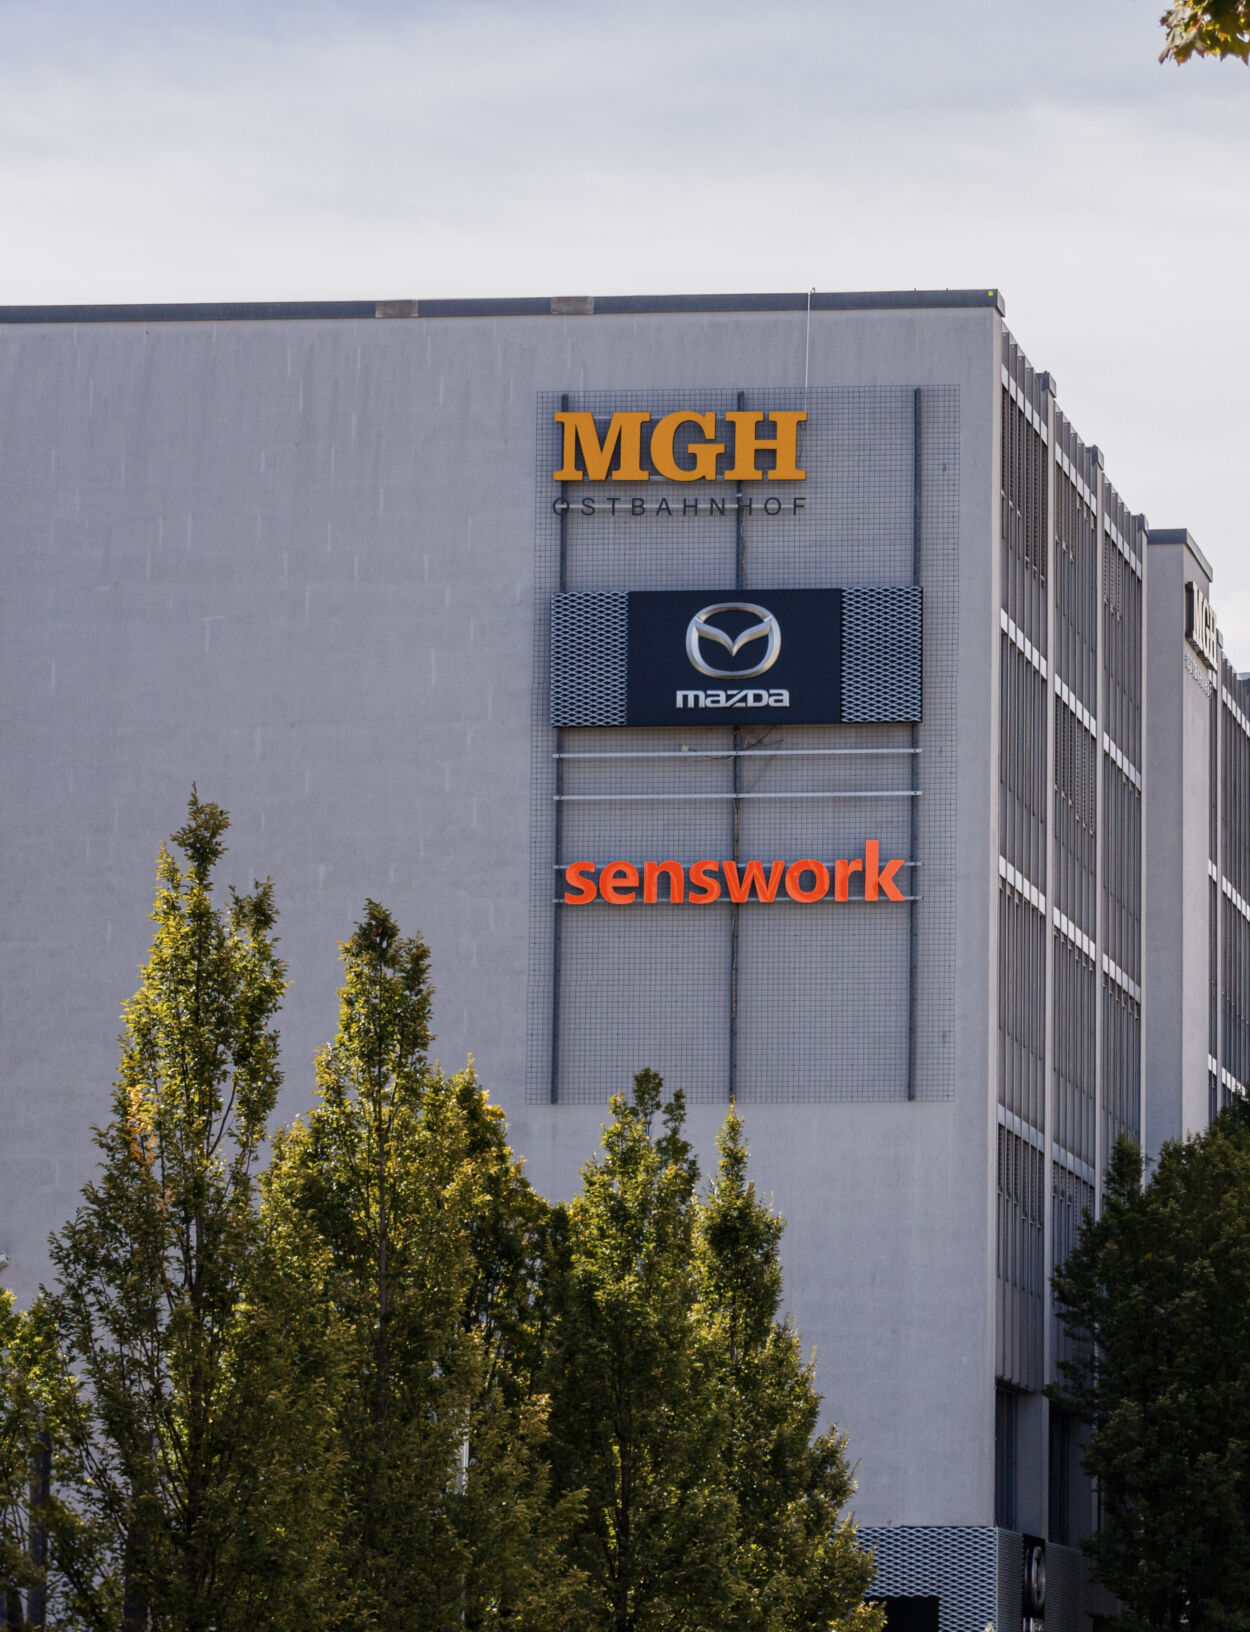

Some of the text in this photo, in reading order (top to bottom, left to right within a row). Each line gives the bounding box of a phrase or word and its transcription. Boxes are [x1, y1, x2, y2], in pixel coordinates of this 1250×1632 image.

[553, 410, 807, 482] MGH
[553, 497, 806, 516] OSTBAHNHOF
[564, 840, 906, 905] senswork
